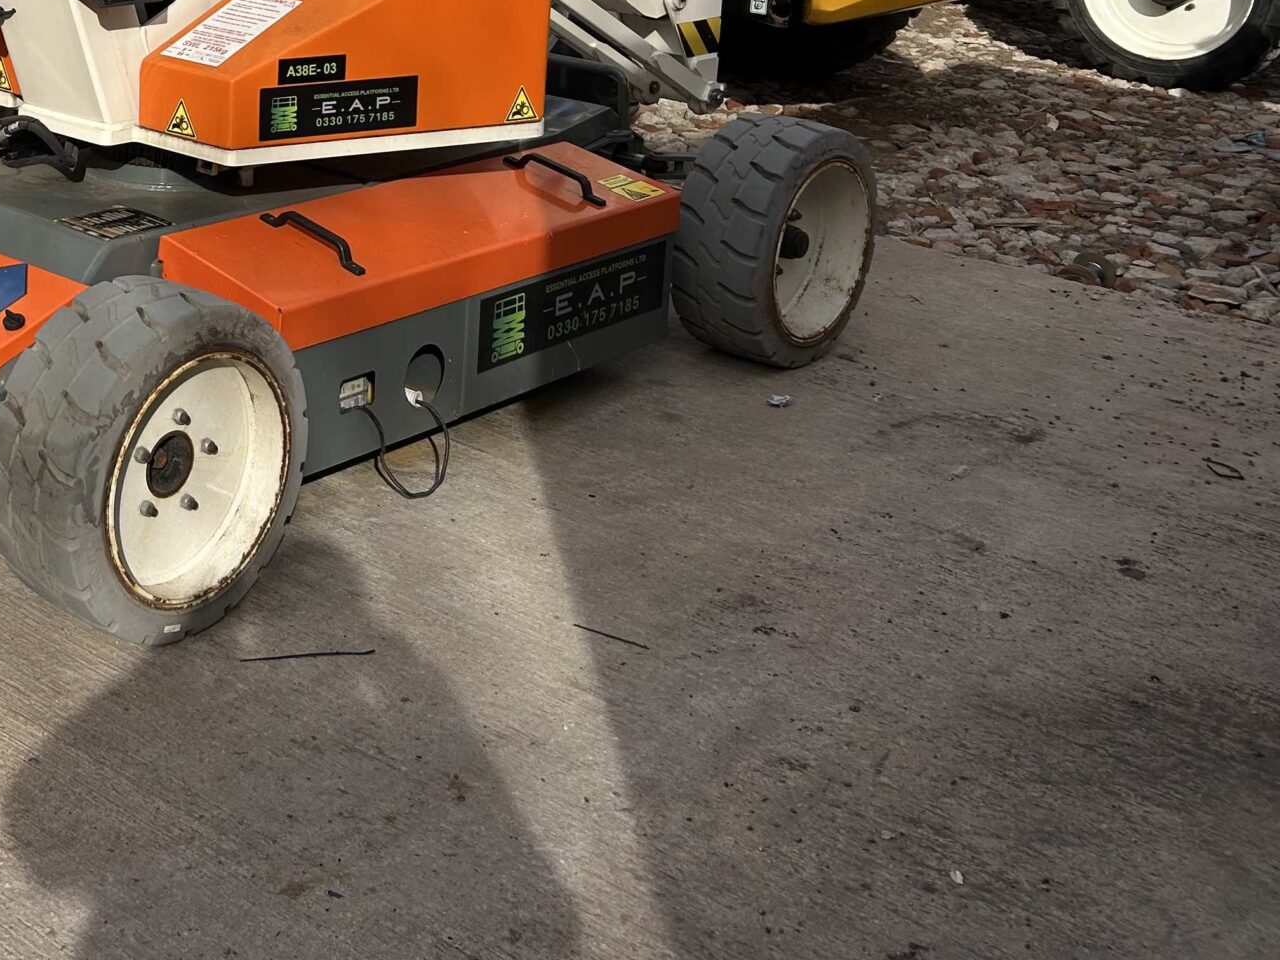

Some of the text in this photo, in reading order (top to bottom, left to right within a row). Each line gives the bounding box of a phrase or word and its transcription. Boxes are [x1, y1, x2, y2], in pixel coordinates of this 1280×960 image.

[182, 40, 228, 55] SWL 215kg
[323, 63, 337, 75] 03
[360, 88, 389, 96] PLATFORMS
[315, 112, 395, 127] 0330 175 7185
[545, 254, 647, 294] ESSENTIAL ACCESS PLATFORMS LTD
[547, 295, 640, 340] 0330 175 7185
